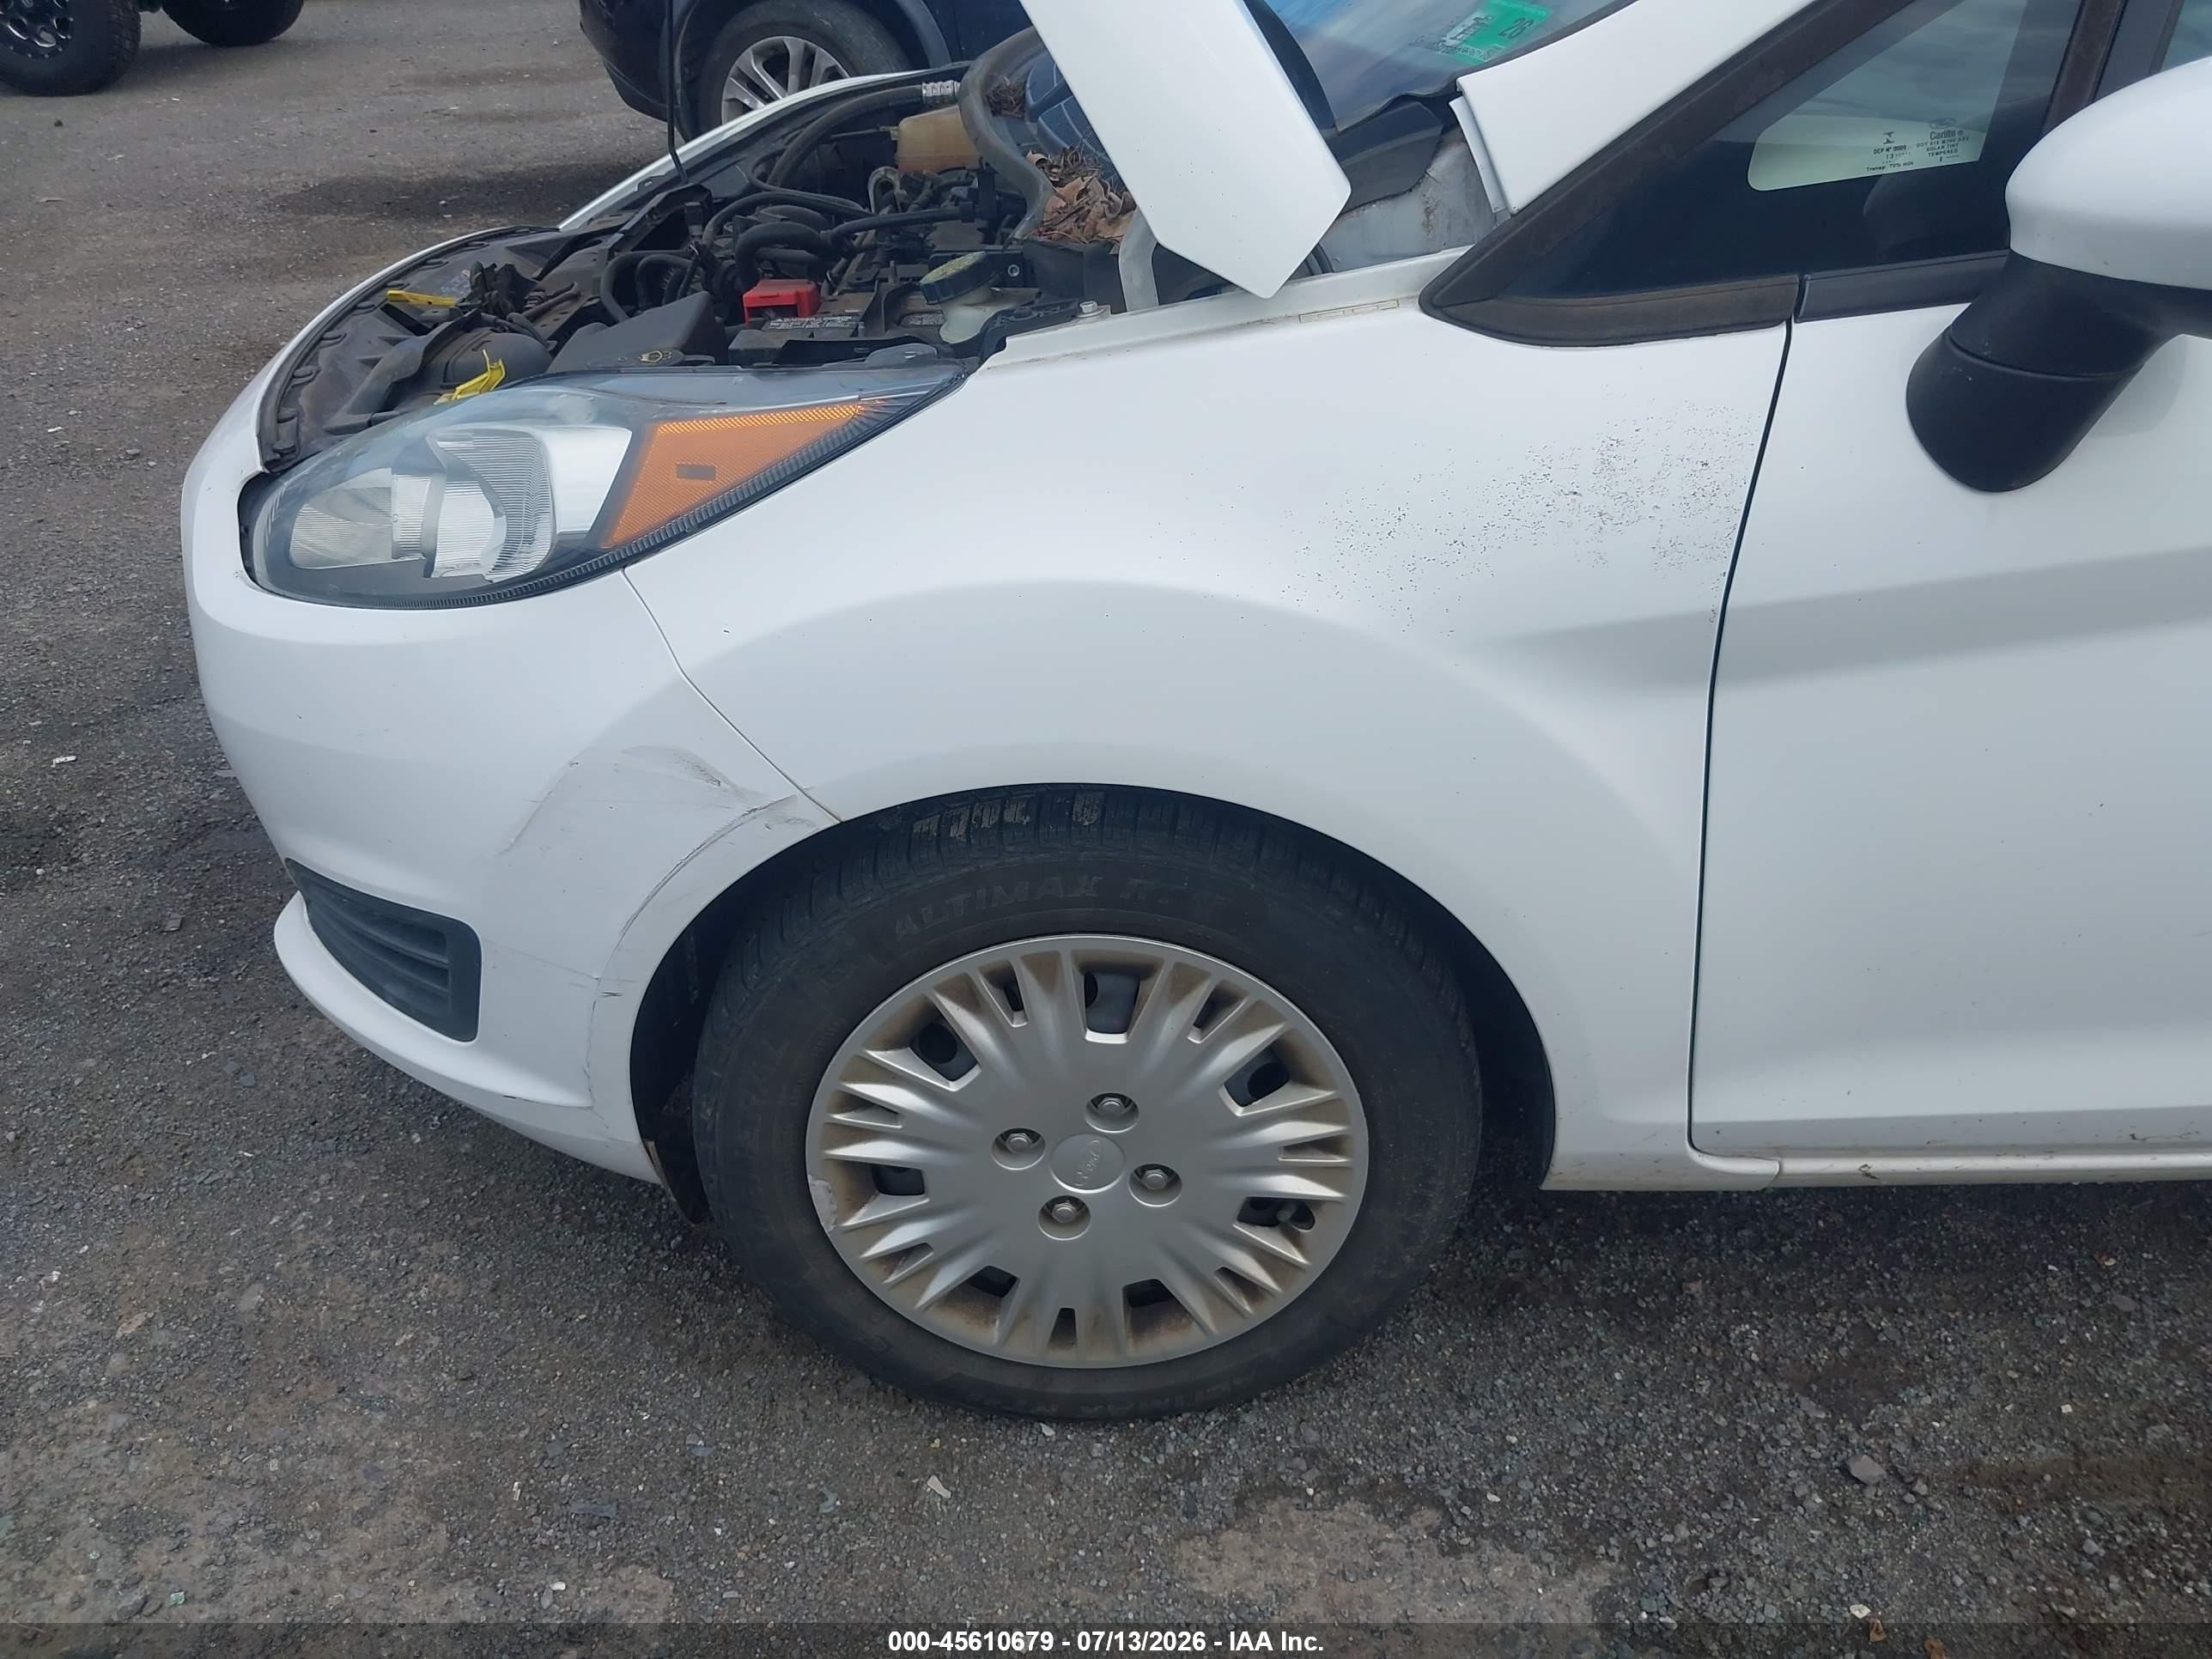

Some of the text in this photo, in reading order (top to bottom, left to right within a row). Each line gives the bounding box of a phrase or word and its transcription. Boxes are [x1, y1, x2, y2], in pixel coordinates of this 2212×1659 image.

[1498, 17, 1534, 40] 26
[1929, 130, 1956, 140] Carlite
[894, 874, 1103, 936] ALTIMAX
